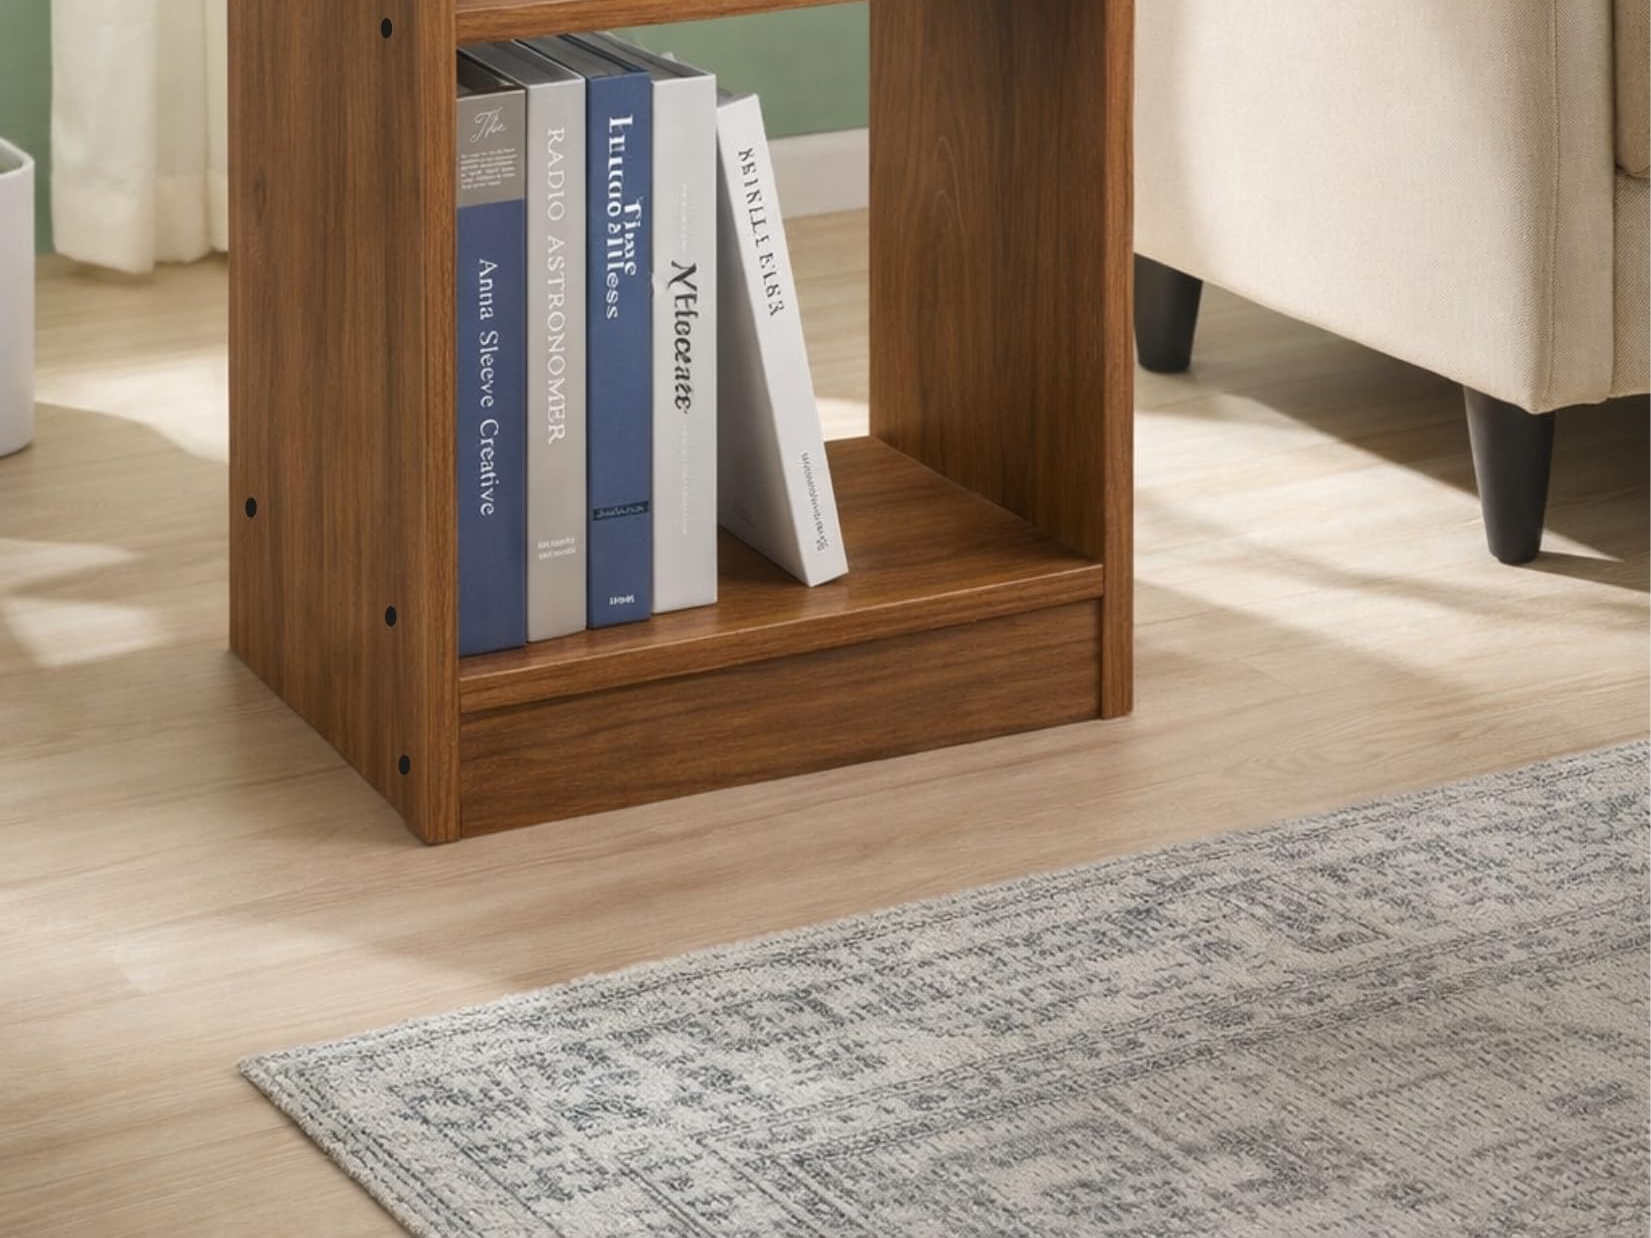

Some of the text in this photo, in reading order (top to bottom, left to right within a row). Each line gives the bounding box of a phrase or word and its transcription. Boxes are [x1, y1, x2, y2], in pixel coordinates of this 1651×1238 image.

[479, 258, 499, 320] Anna
[546, 127, 566, 444] RADIO ASTRONOMER
[479, 418, 500, 516] Creative
